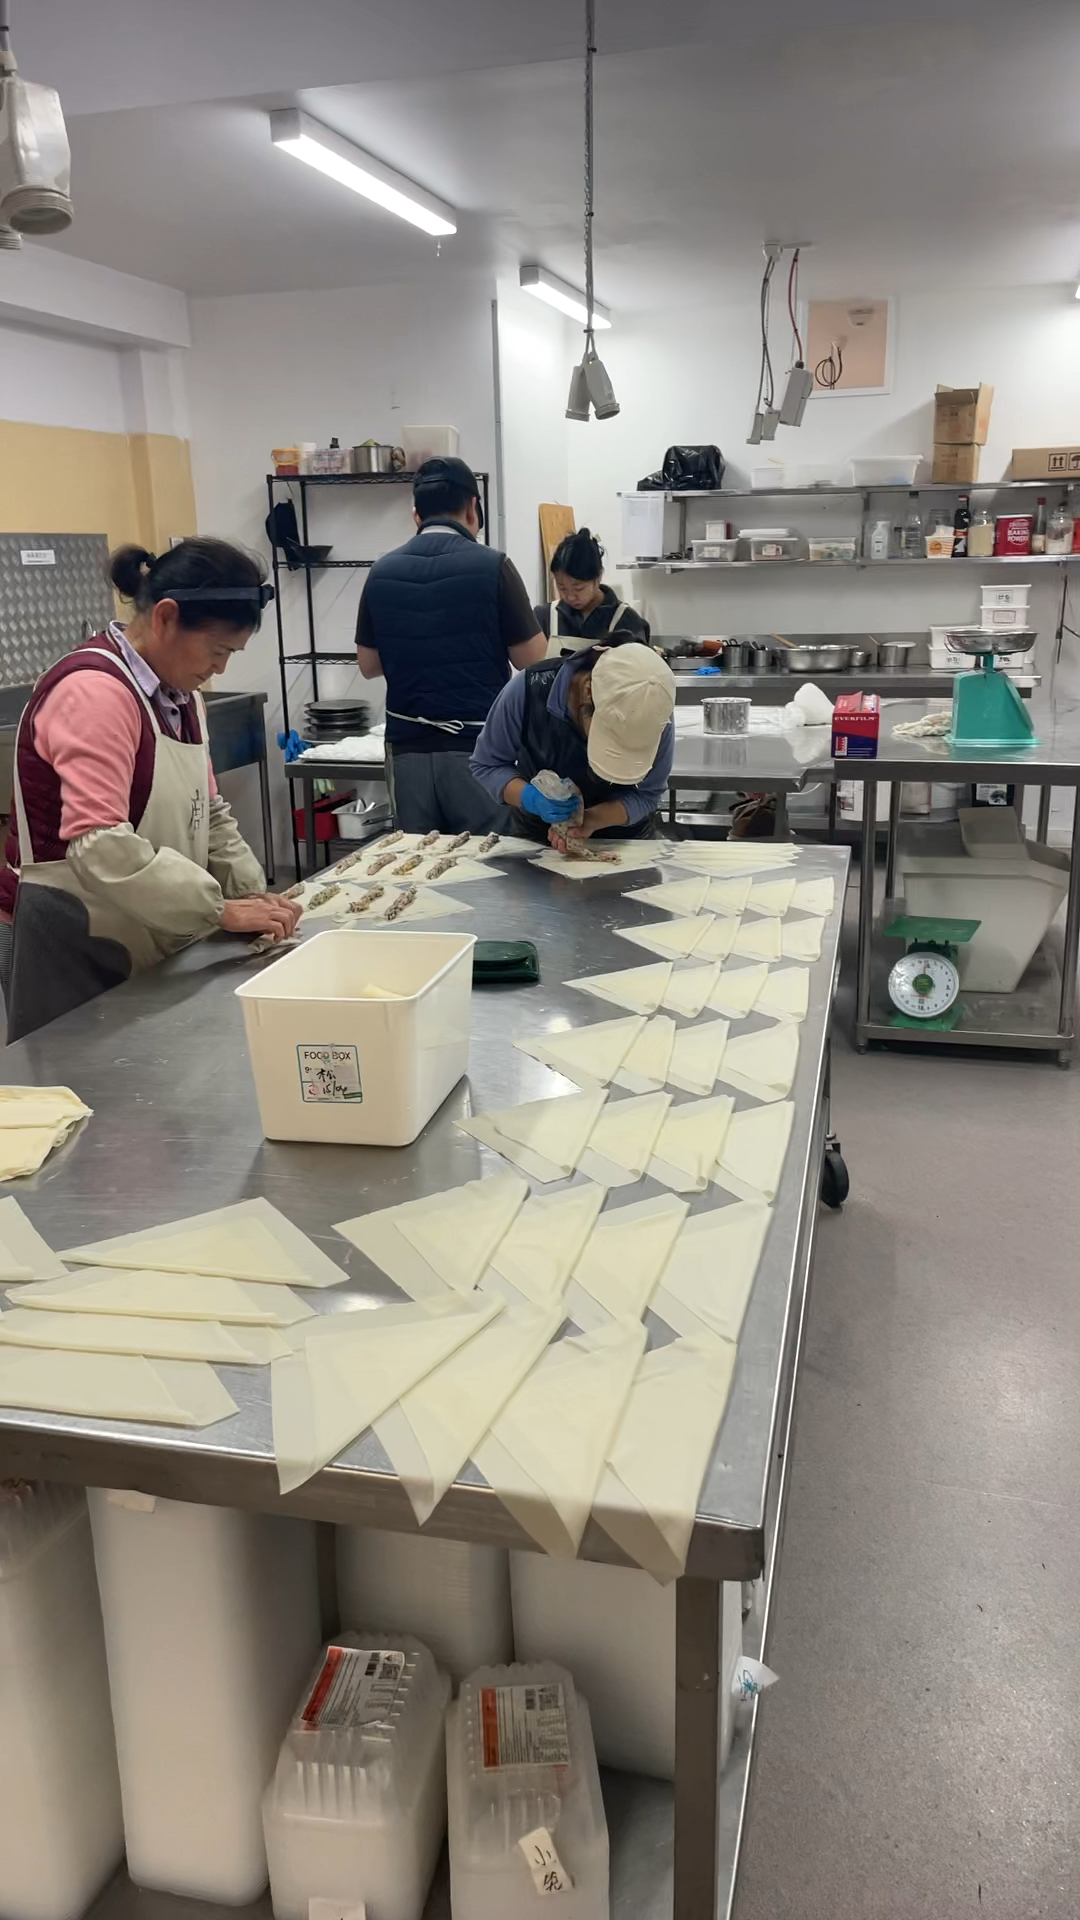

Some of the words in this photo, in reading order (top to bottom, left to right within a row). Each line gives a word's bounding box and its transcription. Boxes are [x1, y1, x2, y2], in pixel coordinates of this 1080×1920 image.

[1007, 528, 1030, 536] BAKING
[304, 1051, 330, 1060] FOOD
[332, 1051, 351, 1061] BOX
